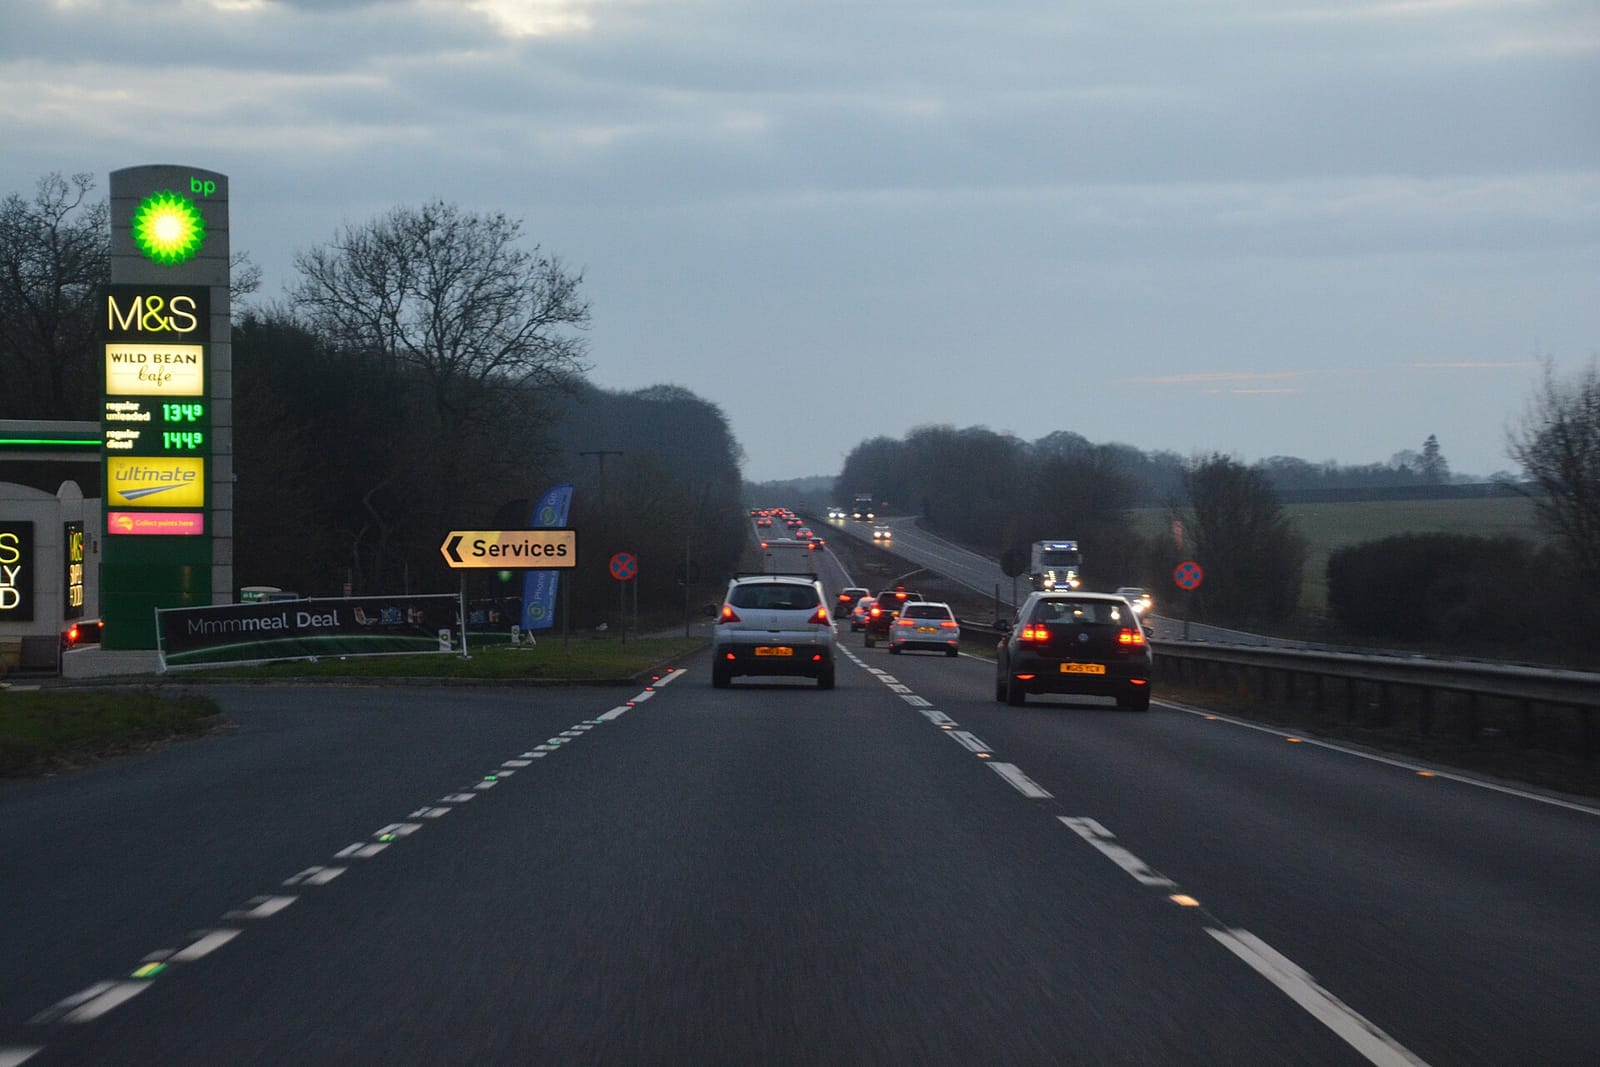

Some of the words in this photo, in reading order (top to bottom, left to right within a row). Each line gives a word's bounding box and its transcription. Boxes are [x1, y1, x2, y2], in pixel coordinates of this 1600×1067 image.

[190, 176, 216, 197] bp
[108, 295, 197, 333] M&S
[111, 353, 147, 364] WILD
[153, 353, 197, 364] BEAN
[115, 466, 196, 482] ultimate
[472, 539, 568, 557] Services
[188, 612, 289, 635] Mmmmeal
[296, 609, 341, 628] Deal
